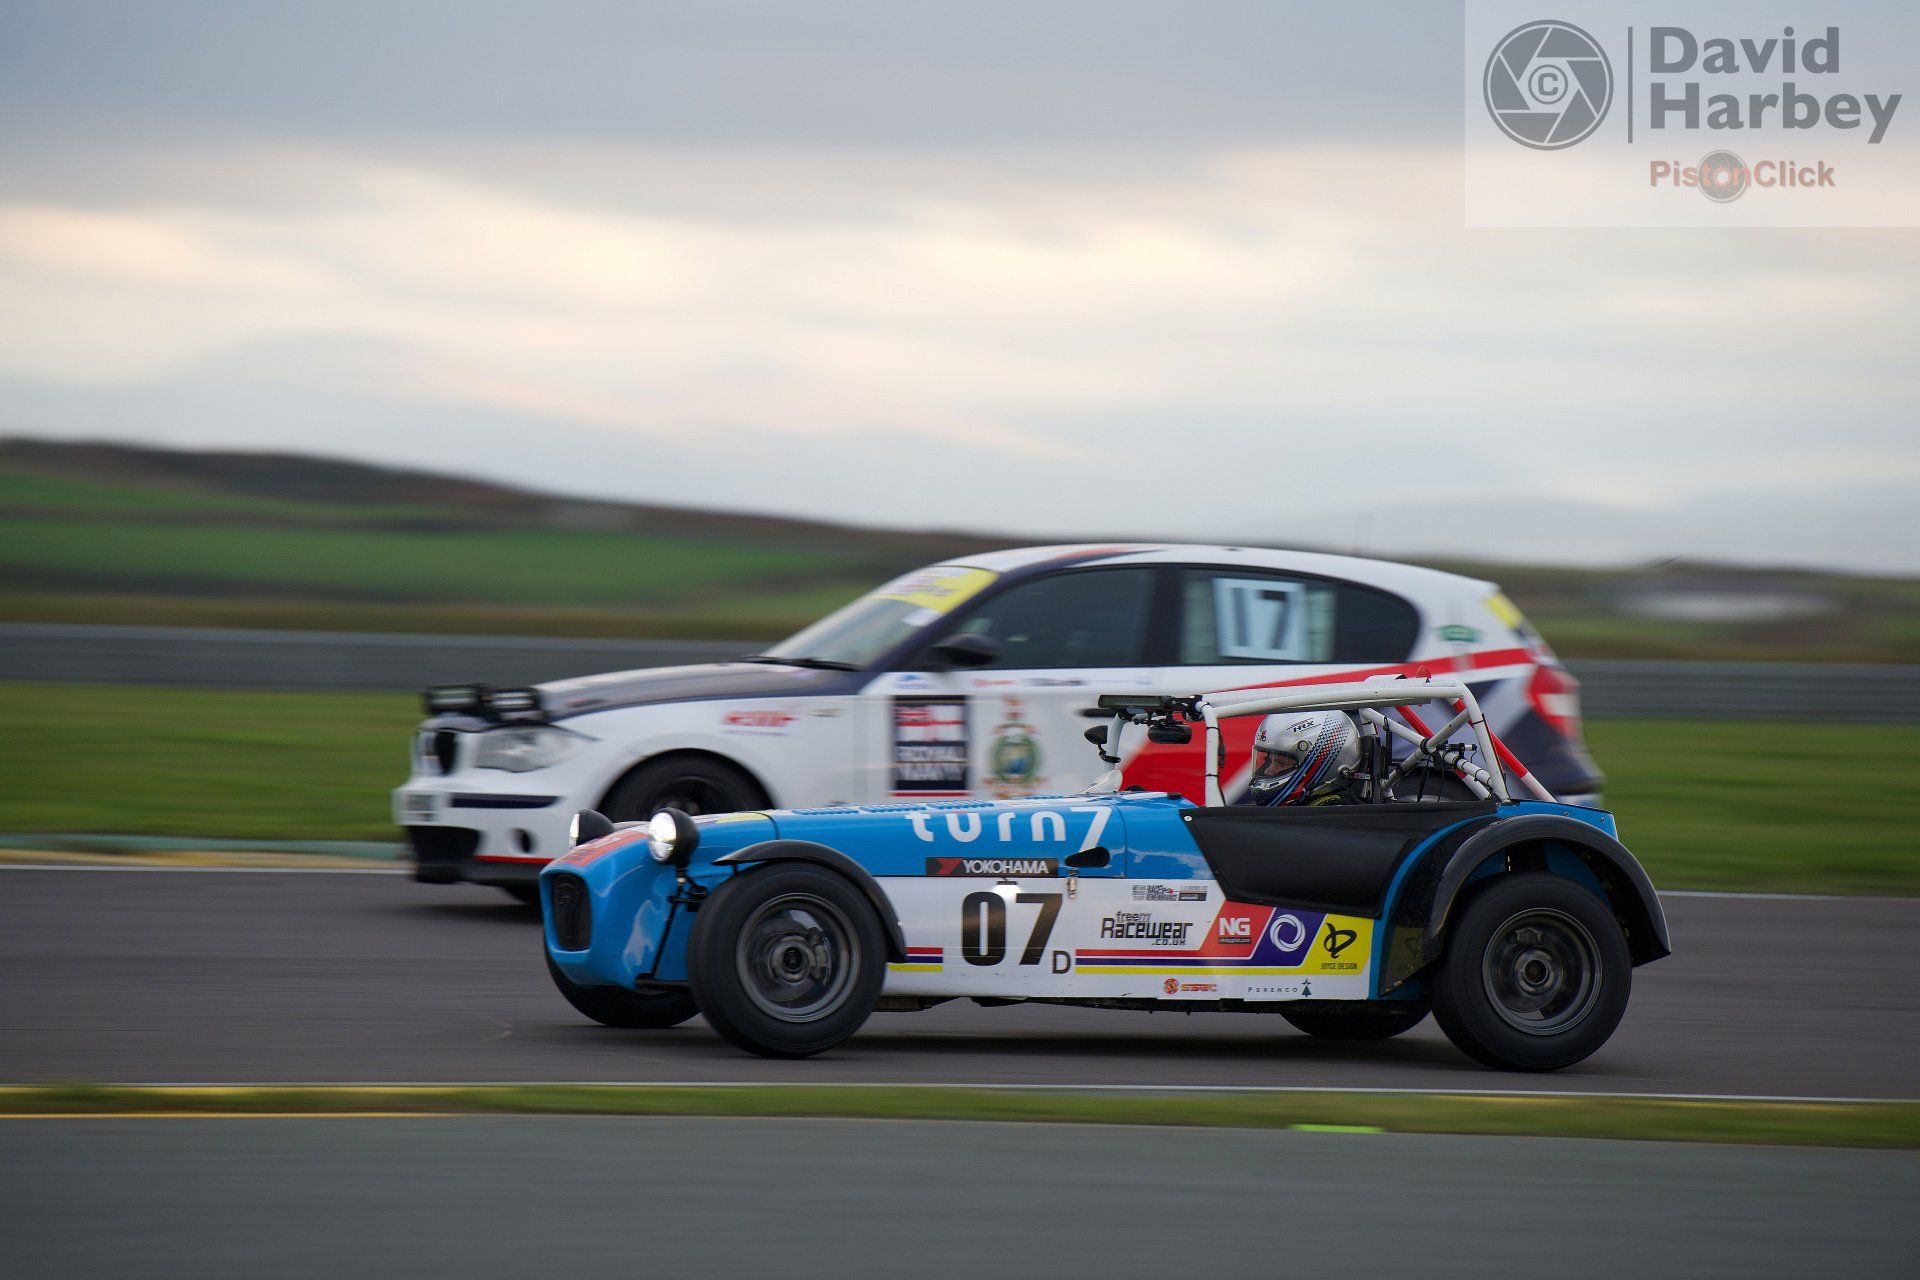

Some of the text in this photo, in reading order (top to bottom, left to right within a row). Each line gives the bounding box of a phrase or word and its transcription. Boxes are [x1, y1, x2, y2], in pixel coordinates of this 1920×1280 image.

[1230, 587, 1294, 650] 17
[904, 806, 1112, 852] turn7
[962, 859, 1049, 874] YOKOHAMA
[962, 891, 1063, 966] 07
[1101, 917, 1193, 939] Racewear
[1218, 917, 1251, 936] NG
[1052, 950, 1071, 974] D
[1338, 962, 1358, 970] DESIGN
